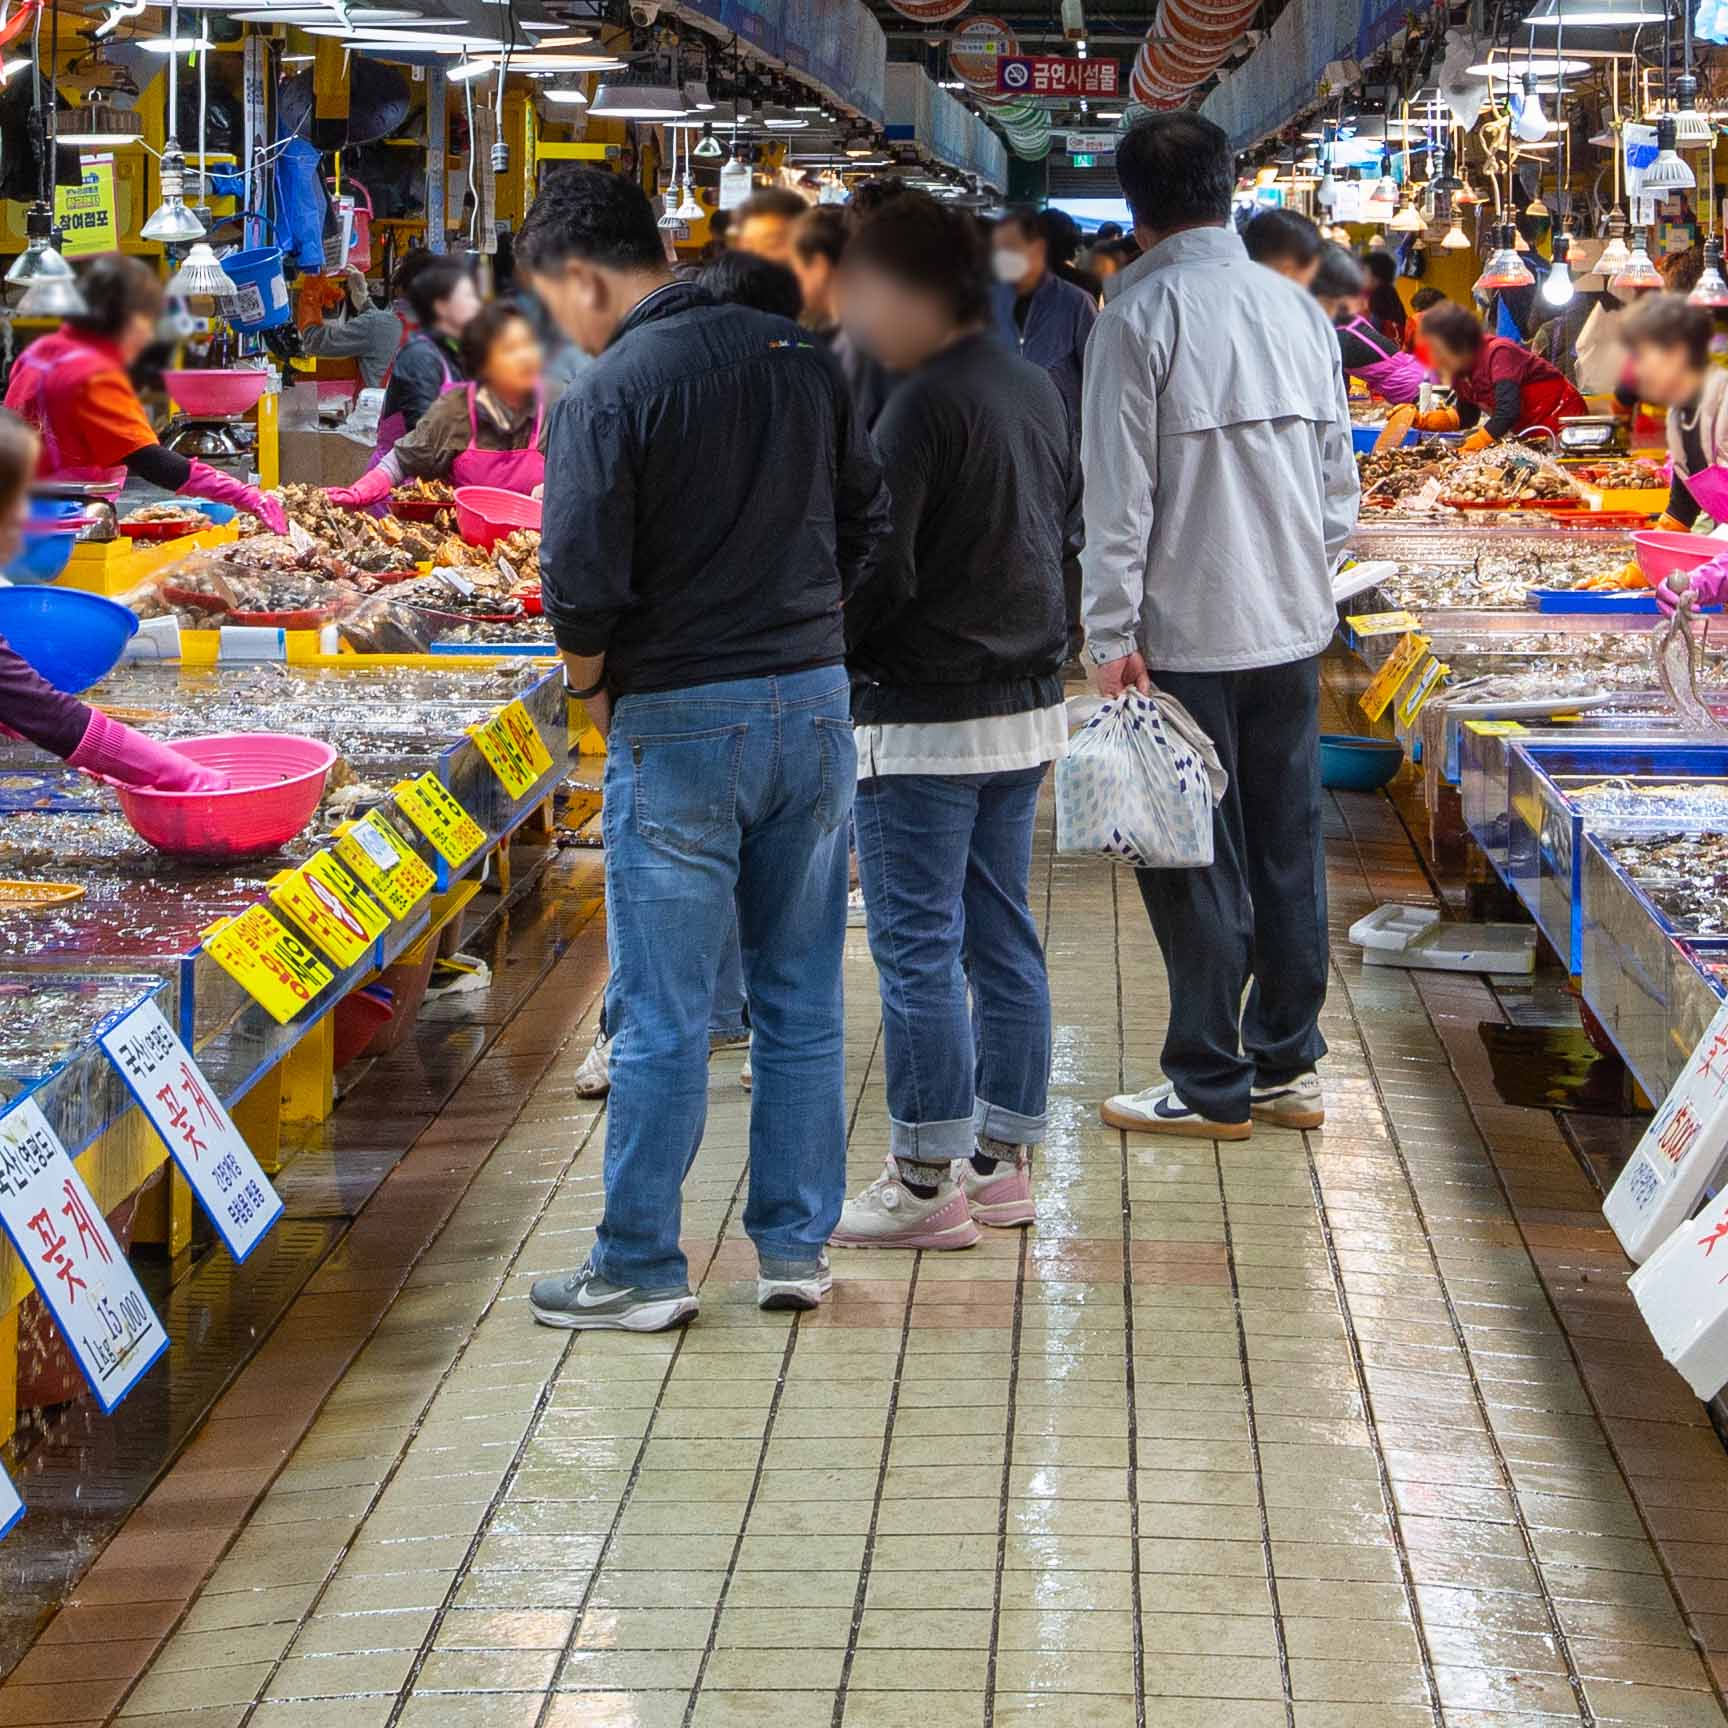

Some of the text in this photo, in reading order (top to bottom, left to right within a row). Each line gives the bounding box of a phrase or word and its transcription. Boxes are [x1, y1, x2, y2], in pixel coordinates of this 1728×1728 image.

[1033, 63, 1116, 92] 금연시설물
[156, 1062, 225, 1161] 꽃게
[28, 1179, 113, 1303] 꽃게
[83, 1335, 117, 1374] 1kg
